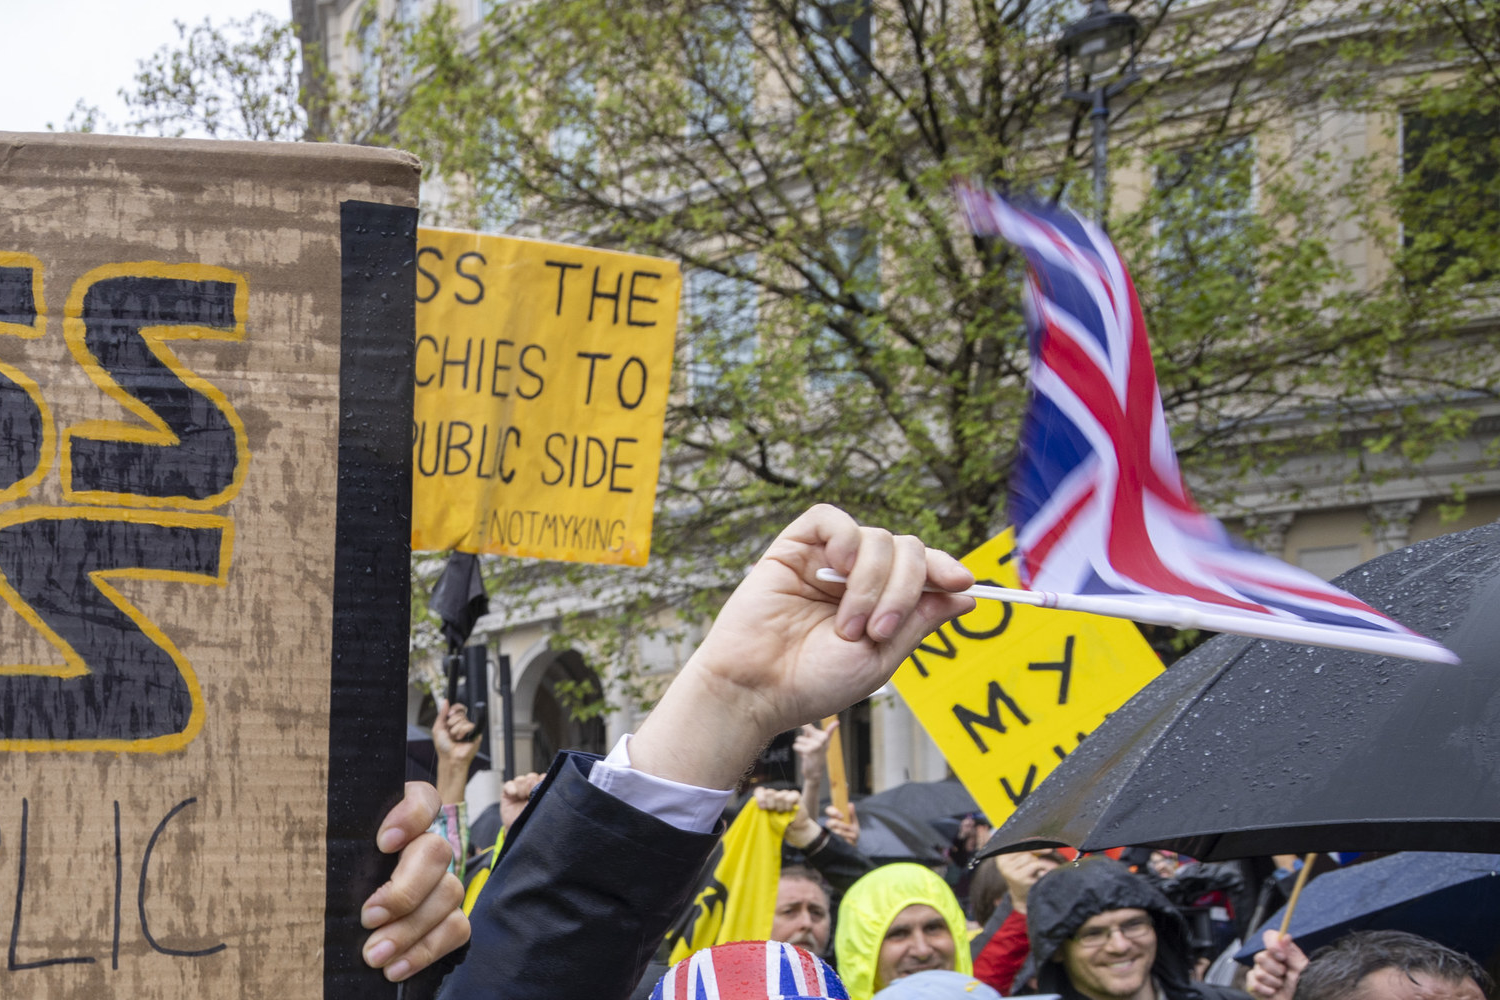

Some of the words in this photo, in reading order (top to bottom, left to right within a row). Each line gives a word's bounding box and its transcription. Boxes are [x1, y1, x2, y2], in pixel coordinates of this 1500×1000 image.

[545, 259, 662, 328] THE
[577, 351, 647, 410] TO
[412, 420, 522, 484] UBLIC
[541, 432, 638, 493] SIDE
[910, 547, 1019, 679] NO
[951, 635, 1076, 755] MY
